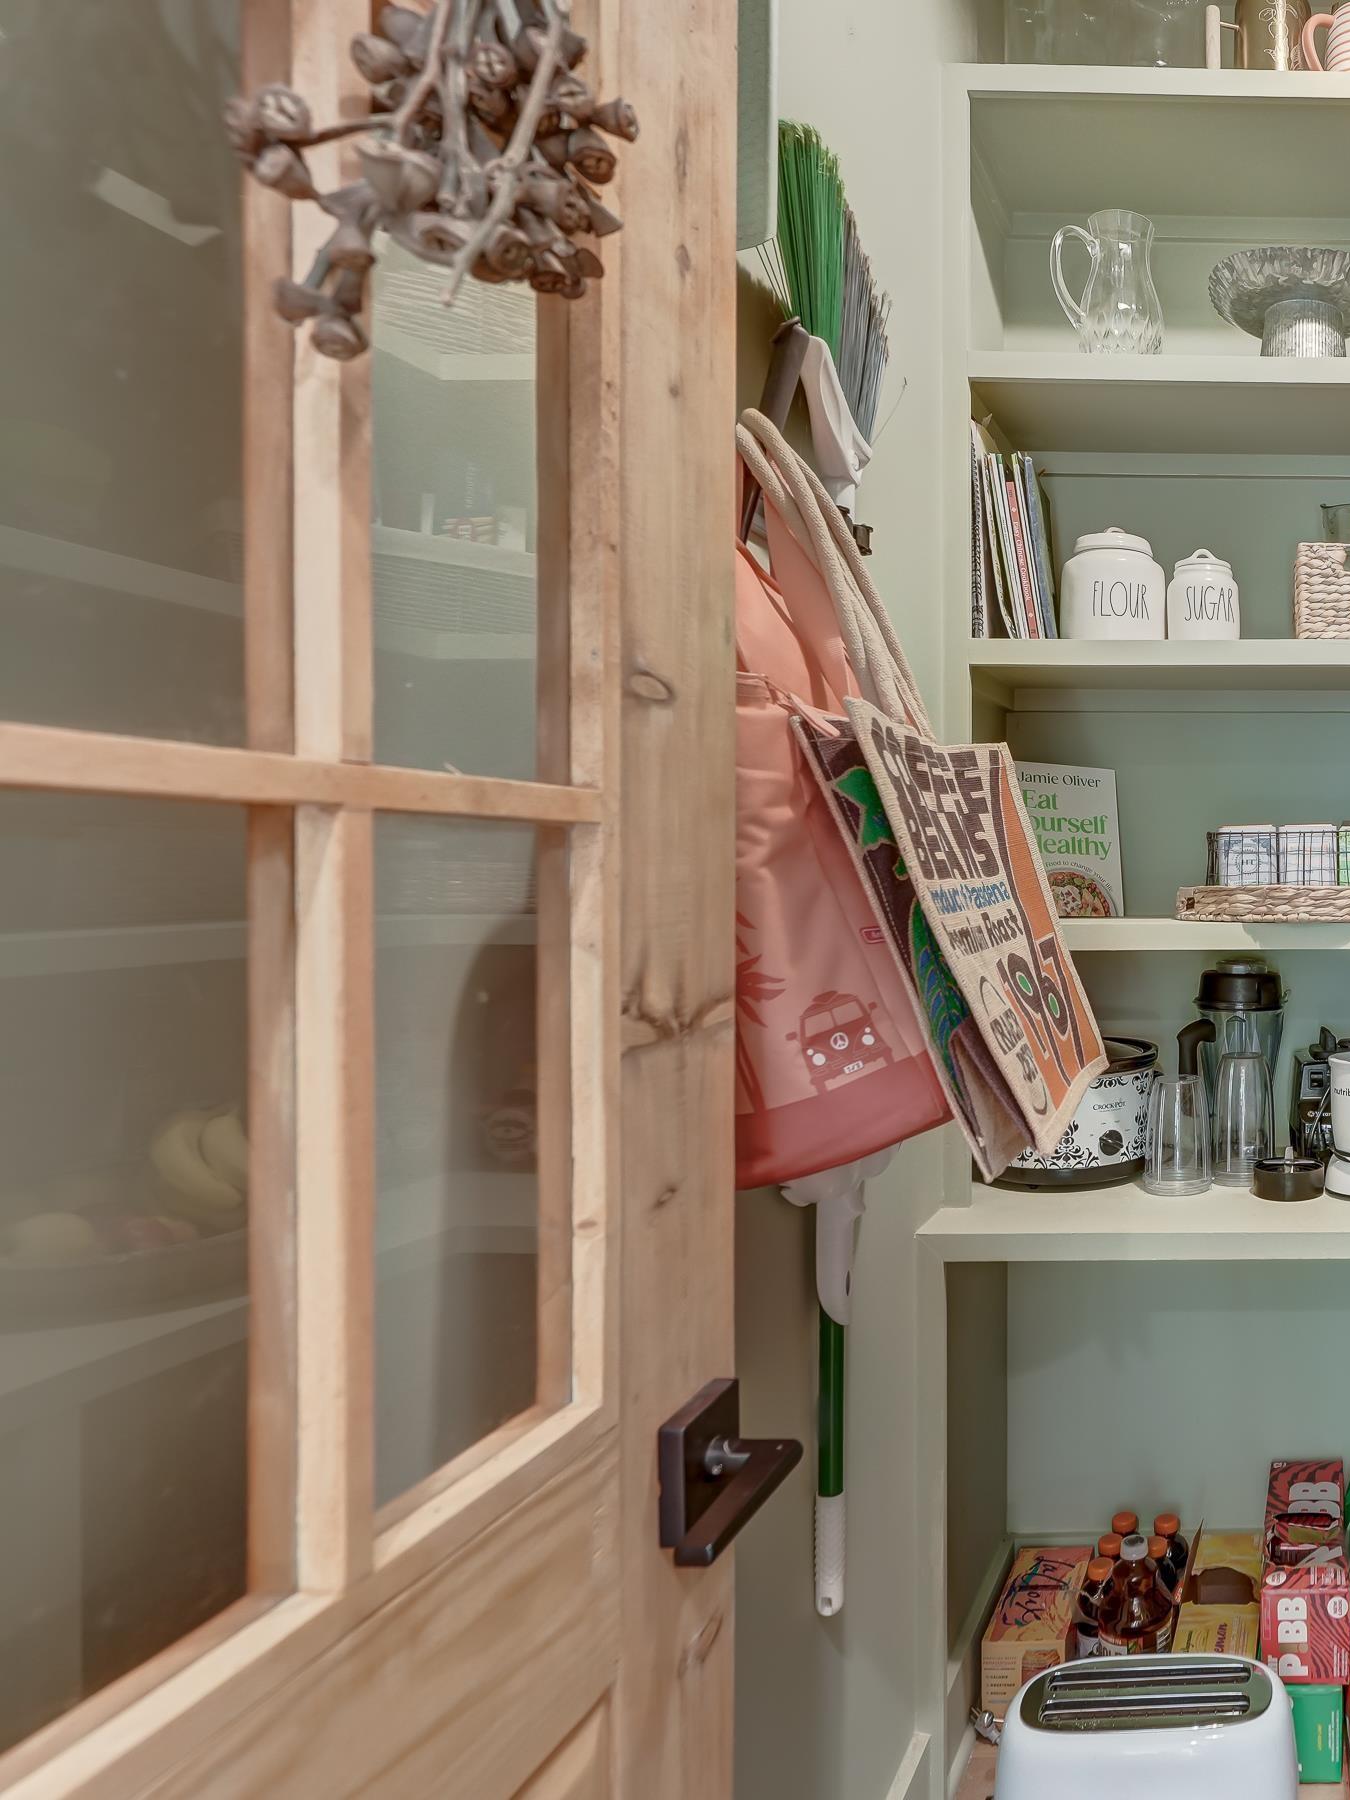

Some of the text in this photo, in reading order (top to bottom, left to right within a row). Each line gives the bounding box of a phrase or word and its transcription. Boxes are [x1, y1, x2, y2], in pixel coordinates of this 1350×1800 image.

[1092, 580, 1150, 620] FLOUR
[1184, 585, 1235, 623] SUGAR
[1017, 771, 1102, 788] Jamie Oliver
[1022, 788, 1059, 810] Eat
[981, 908, 1024, 949] Roast
